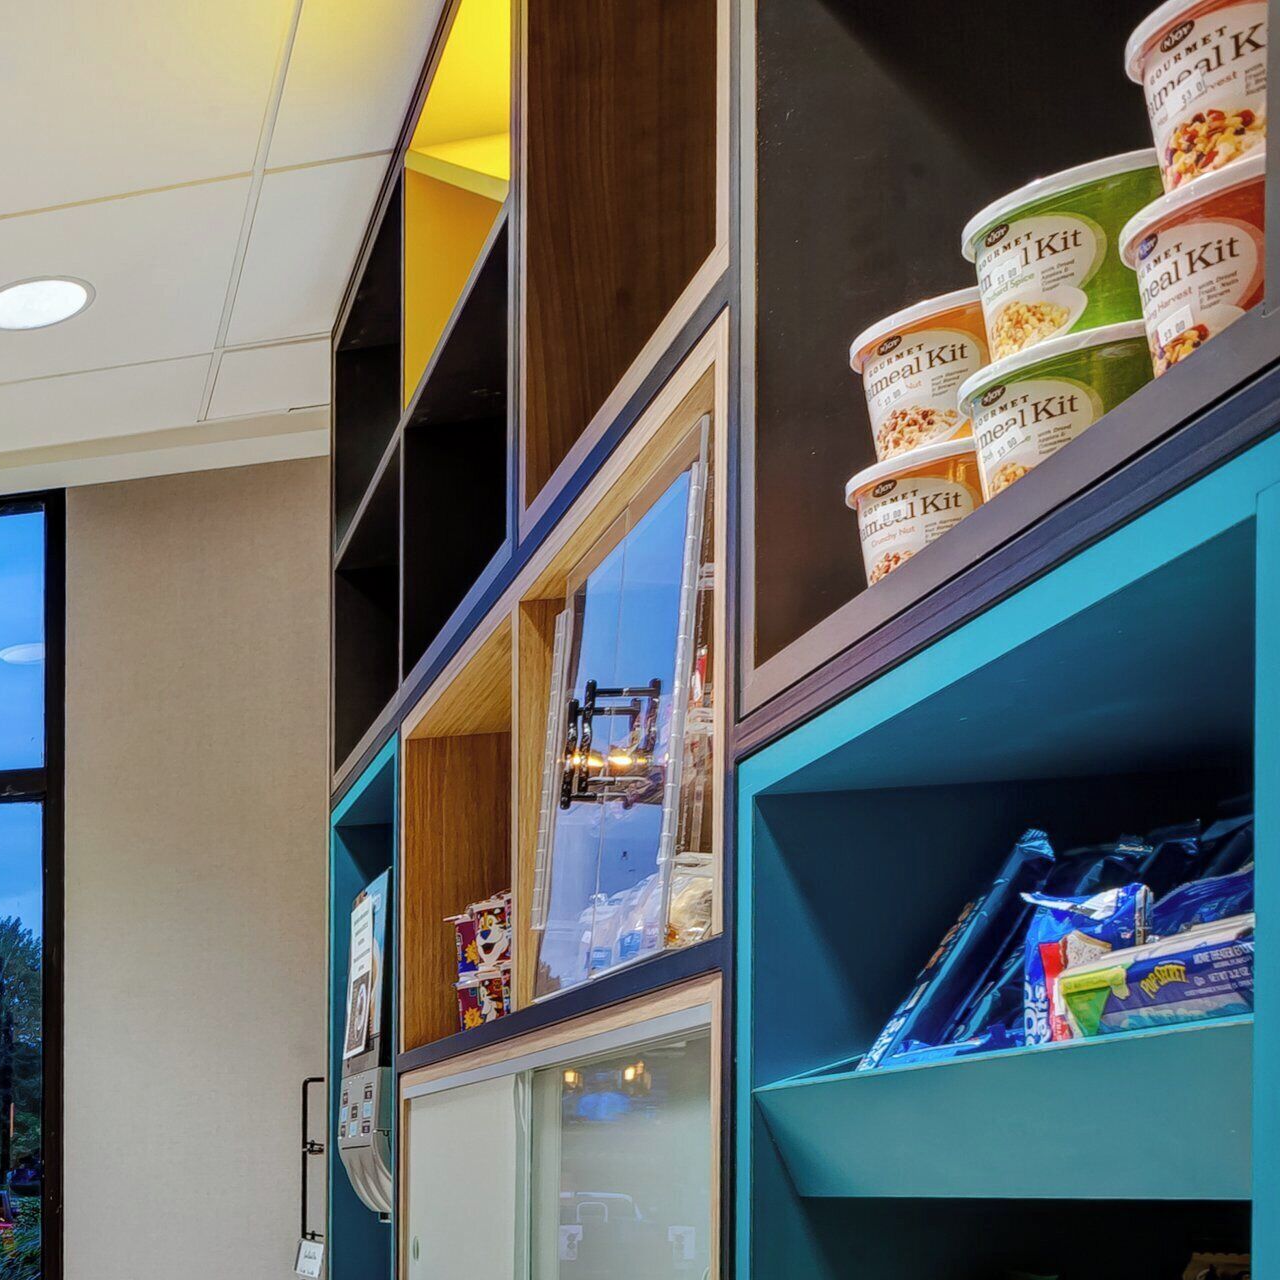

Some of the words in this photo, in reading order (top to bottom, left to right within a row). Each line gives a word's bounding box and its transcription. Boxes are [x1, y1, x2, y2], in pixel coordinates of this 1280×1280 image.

[1149, 25, 1228, 86] GOURMET
[1035, 229, 1083, 261] Kit
[1185, 236, 1241, 277] Kit
[1010, 272, 1035, 290] Spice
[926, 343, 969, 370] Kit
[979, 409, 1027, 450] meal
[1030, 394, 1080, 425] Kit
[920, 492, 962, 516] Kit
[899, 525, 916, 535] Nut
